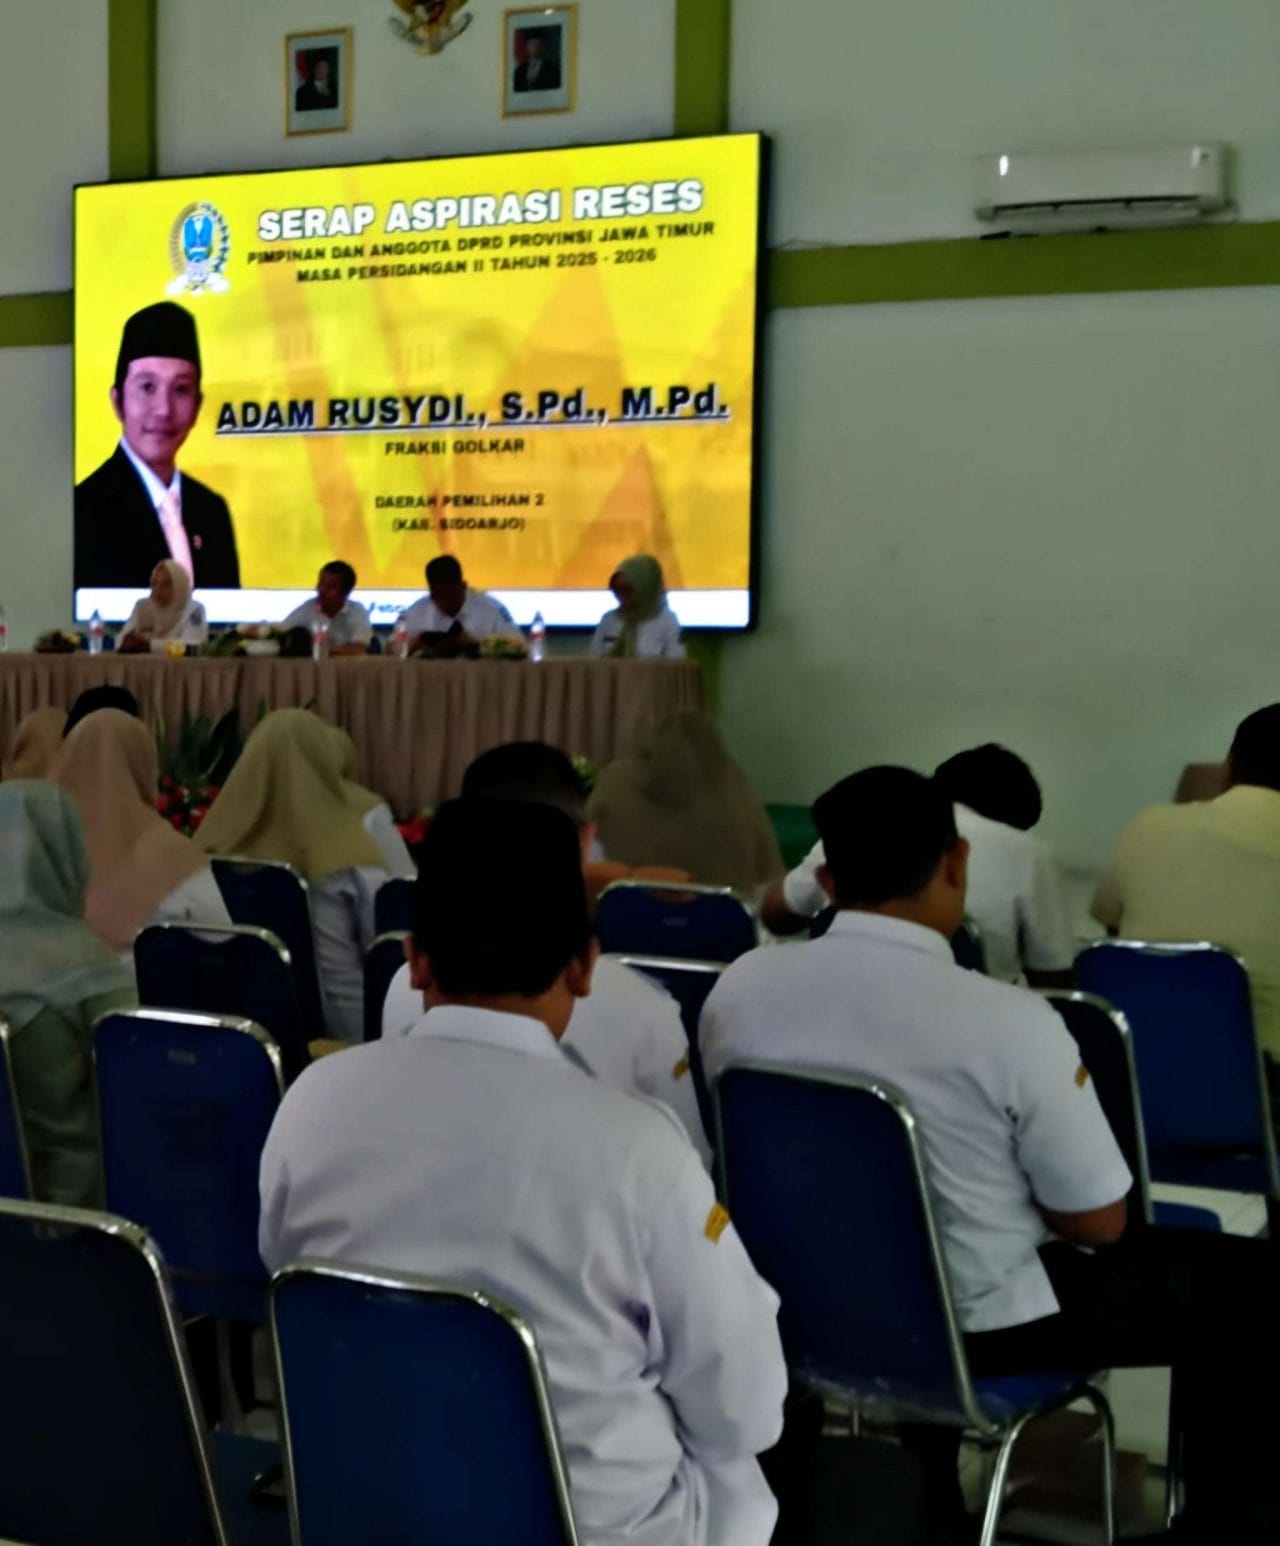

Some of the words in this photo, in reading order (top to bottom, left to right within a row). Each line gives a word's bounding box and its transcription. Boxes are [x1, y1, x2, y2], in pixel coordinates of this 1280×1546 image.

[258, 204, 375, 241] SERAP
[385, 188, 562, 233] ASPIRASI
[573, 178, 703, 220] RESES
[248, 246, 326, 264] PIMPINAN
[331, 245, 364, 259] DAN
[370, 239, 451, 256] ANGGOTA
[457, 235, 502, 251] DPRD
[509, 230, 593, 247] PROVINSI
[599, 226, 649, 242] JAWA
[655, 222, 715, 238] TIMUR
[296, 267, 342, 282] MASA
[347, 262, 467, 280] PERSIDANGAN
[473, 260, 484, 273] II
[492, 253, 551, 271] TAHUN
[556, 252, 597, 267] 2025
[614, 248, 657, 264] 2026
[217, 400, 315, 428] ADAM
[501, 388, 607, 425] S.Pd.,
[621, 382, 729, 418] M.Pd.
[385, 440, 446, 455] FRAKSI
[453, 438, 525, 454] GOLKAR
[375, 495, 437, 509] DAERAH
[443, 494, 530, 507] PEMILIHAN
[535, 493, 545, 506] 2
